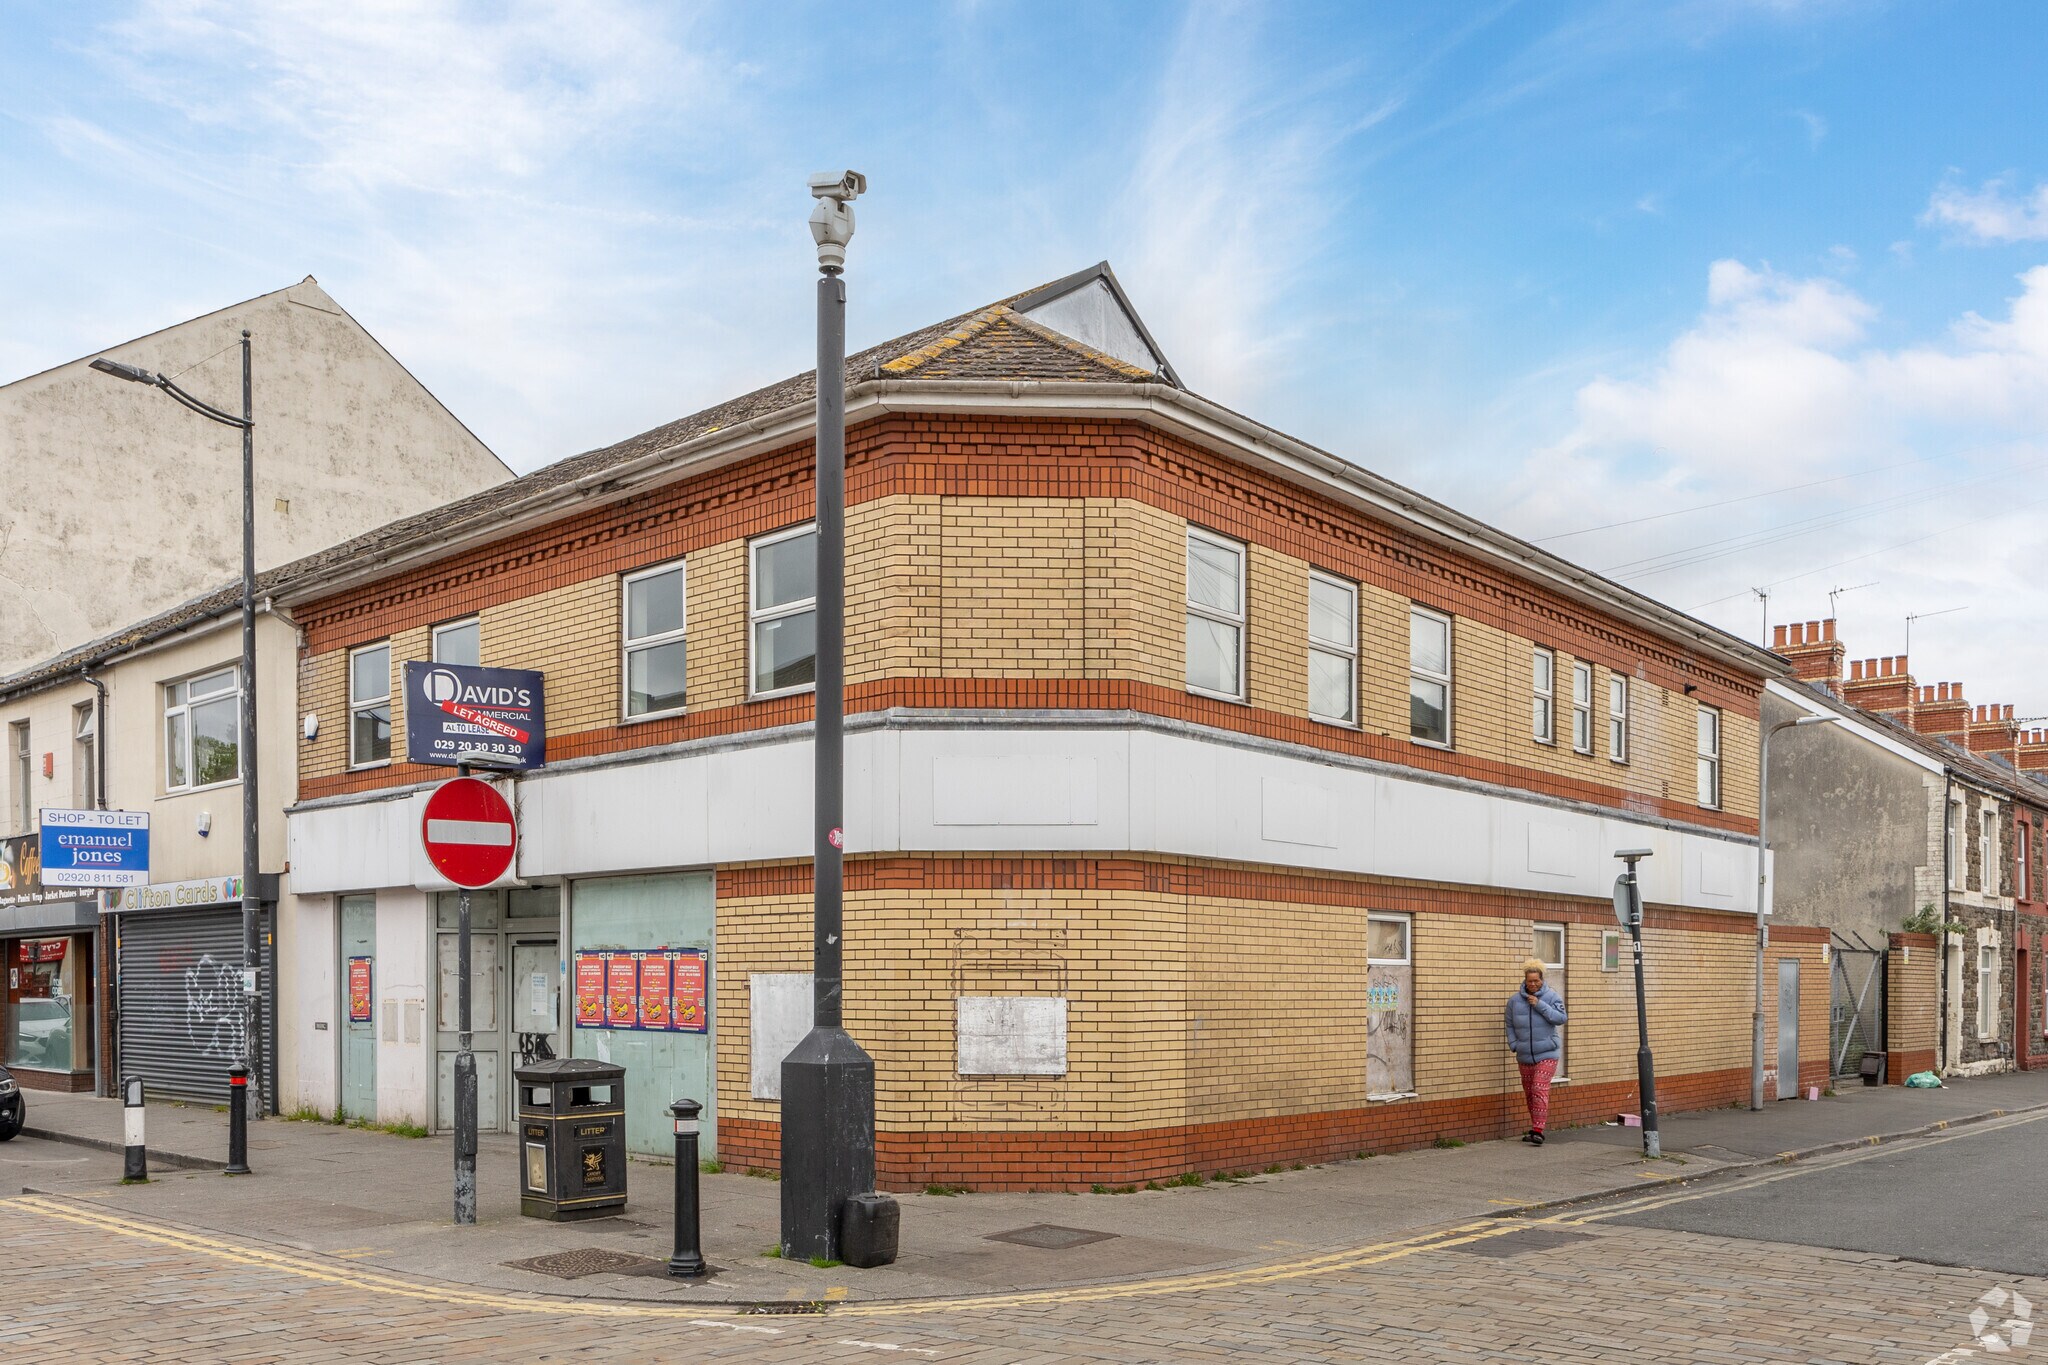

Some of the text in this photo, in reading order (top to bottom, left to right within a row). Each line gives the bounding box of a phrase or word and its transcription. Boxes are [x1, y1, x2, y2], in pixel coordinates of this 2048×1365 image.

[423, 669, 531, 707] DAVID'S
[453, 705, 518, 738] LET AGREED
[456, 723, 490, 734] TO LEASE
[434, 739, 521, 754] 029 20 30 30 30
[48, 812, 86, 824] SHOP
[97, 814, 115, 825] TO
[118, 815, 142, 826] LET
[58, 831, 133, 847] emanuel
[71, 847, 122, 866] jones
[57, 872, 135, 884] 02920 811 581
[125, 880, 217, 909] Clifton Cards
[528, 1128, 545, 1137] LITTER
[580, 1126, 605, 1136] LITTER
